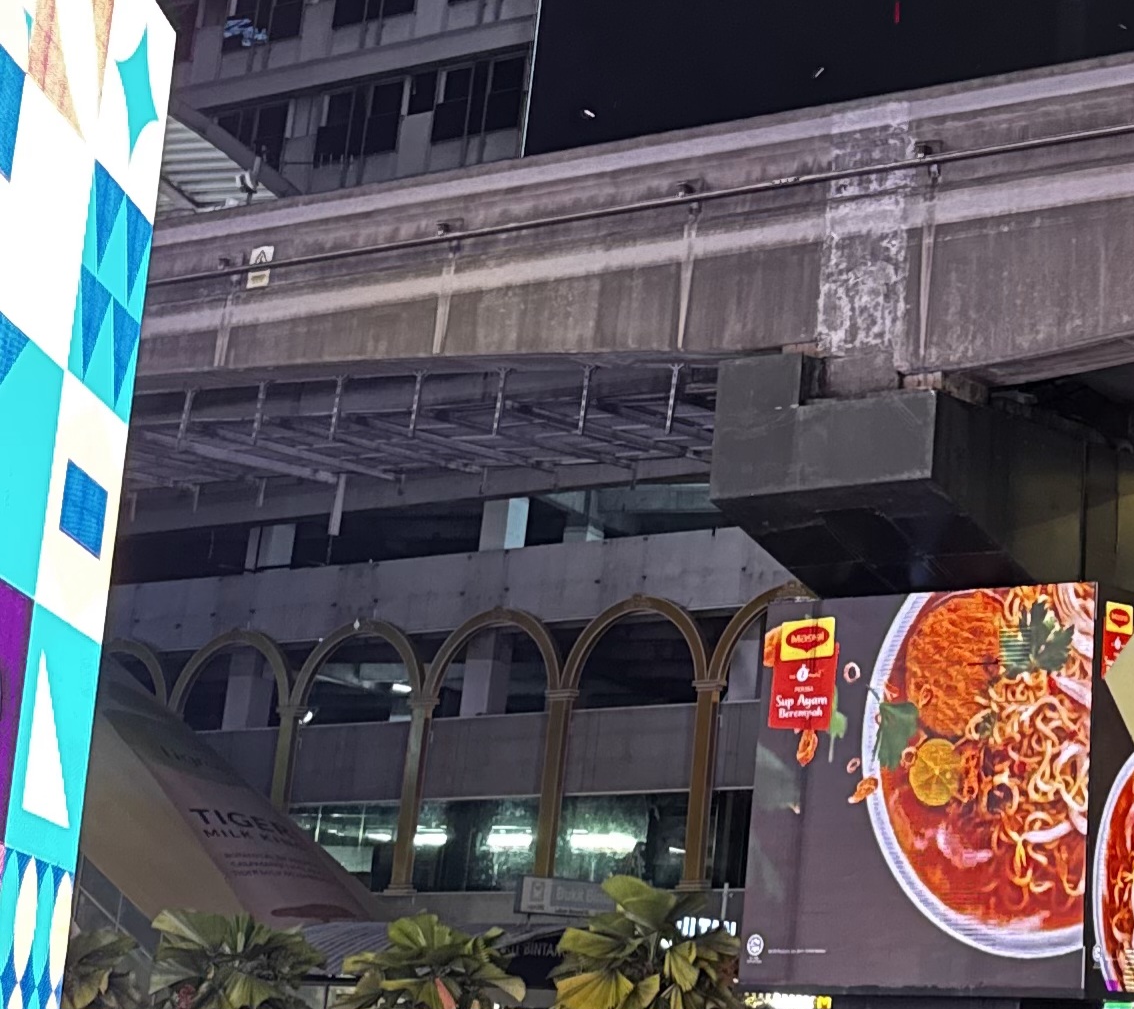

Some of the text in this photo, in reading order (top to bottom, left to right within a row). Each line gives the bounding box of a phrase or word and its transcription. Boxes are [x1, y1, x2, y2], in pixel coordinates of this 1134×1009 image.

[776, 694, 828, 710] Sup Ayam
[778, 706, 823, 720] Berempah
[189, 808, 289, 836] TIGER
[203, 829, 253, 839] MILK
